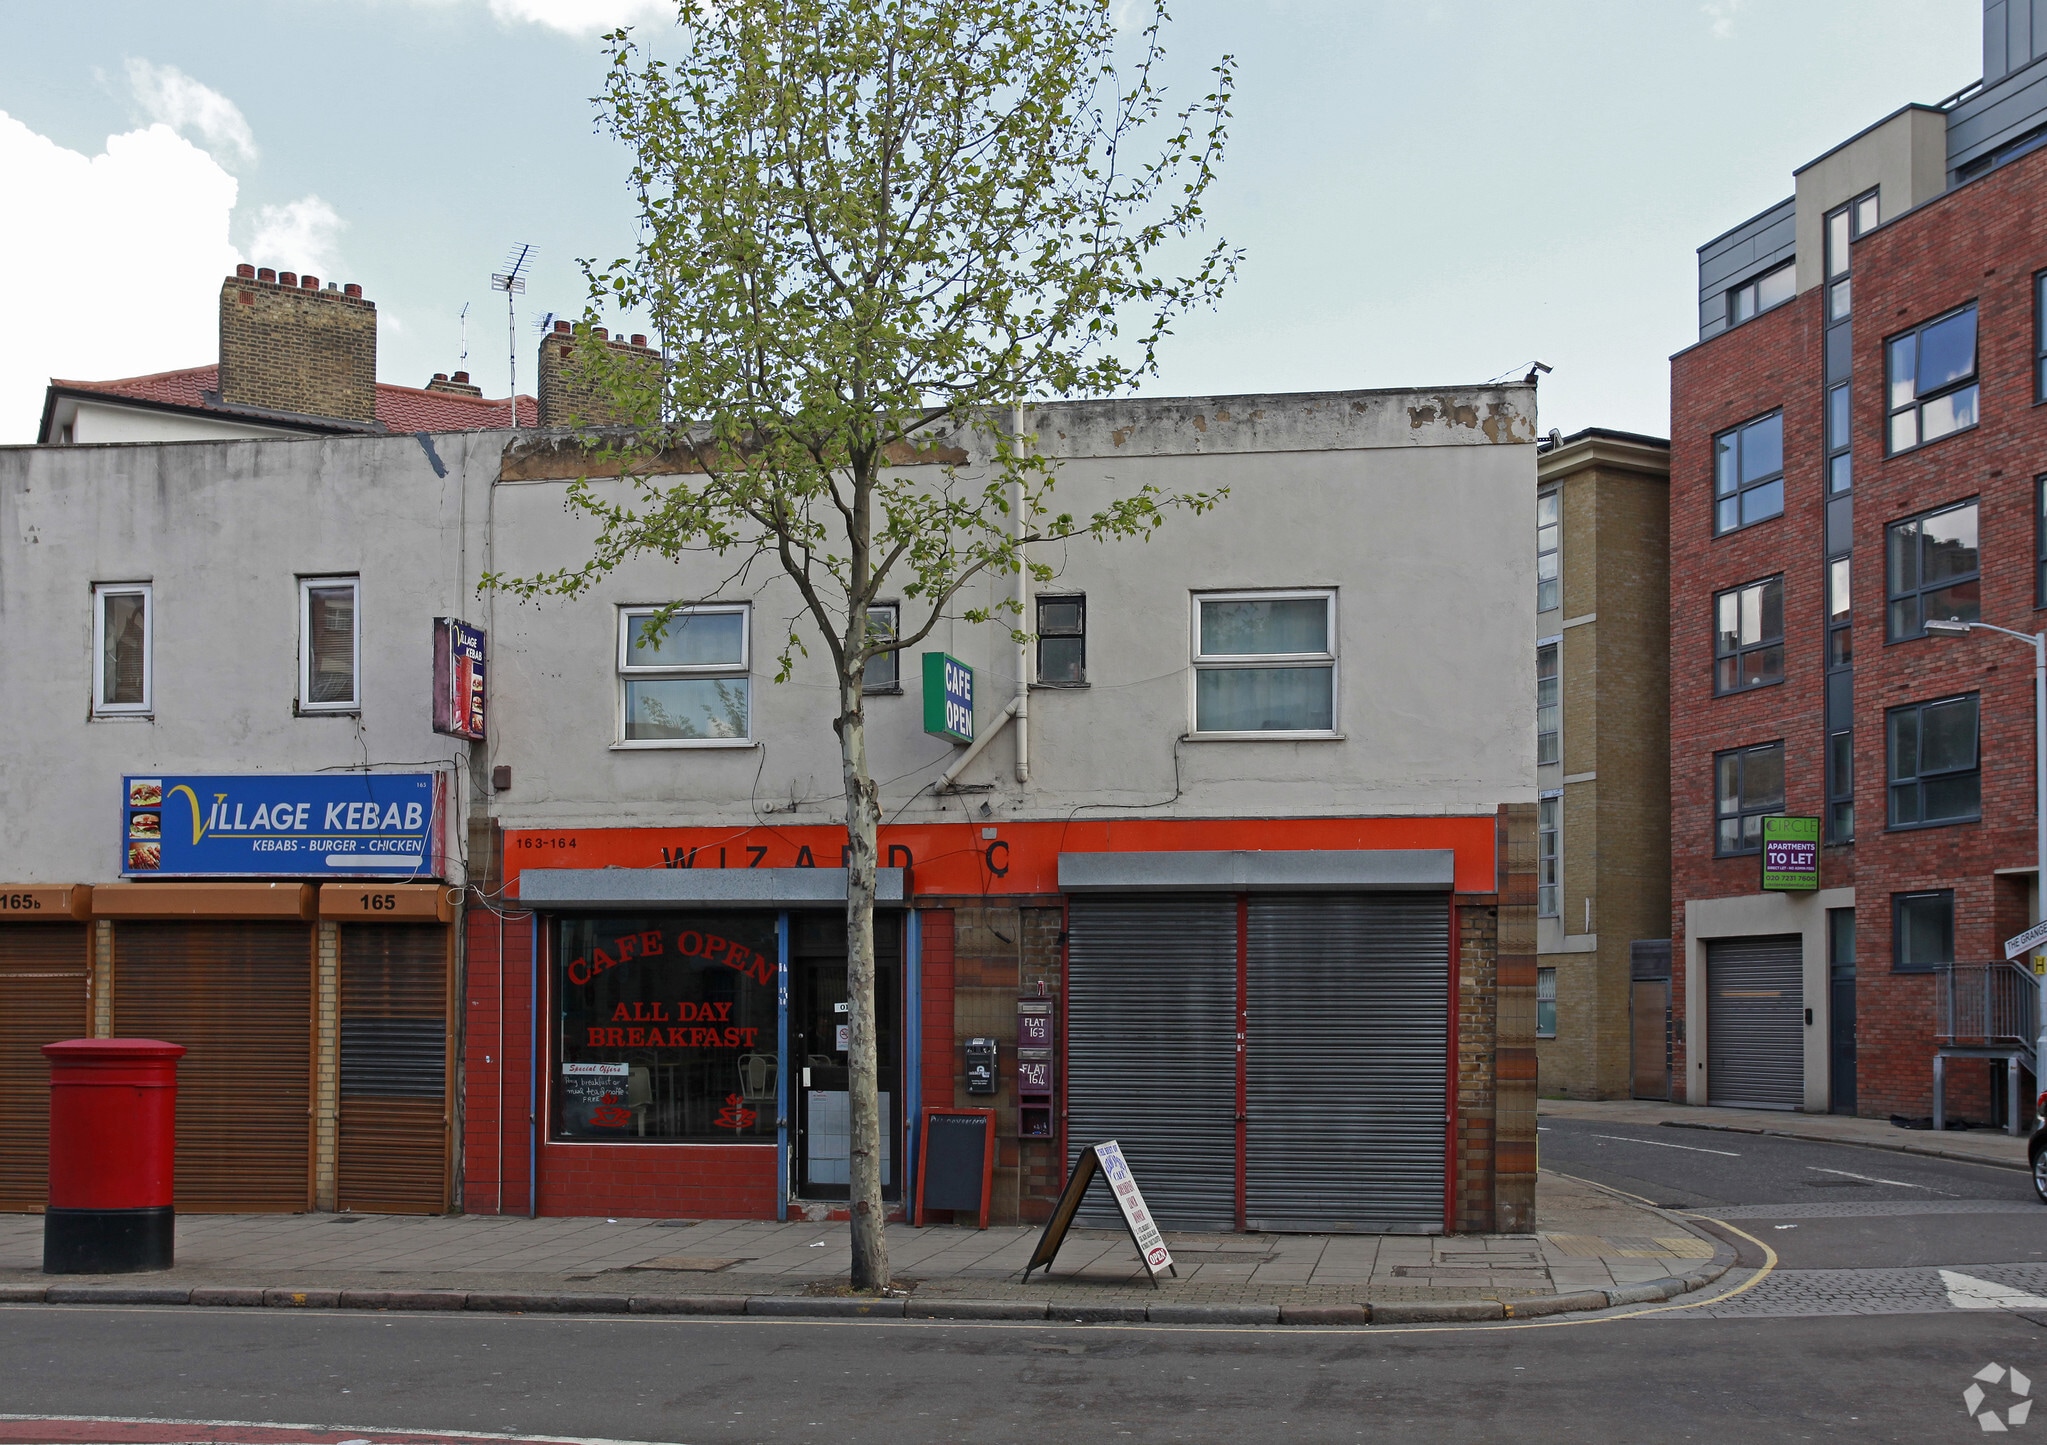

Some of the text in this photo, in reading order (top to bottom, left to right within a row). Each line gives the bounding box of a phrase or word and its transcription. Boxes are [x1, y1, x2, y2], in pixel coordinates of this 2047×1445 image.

[453, 625, 478, 648] VILLAGE
[465, 647, 483, 661] KEBAB
[945, 662, 971, 701] CAFE
[946, 700, 972, 737] OPEN
[167, 785, 423, 846] VILLAGE KEBAB
[1766, 819, 1817, 833] CIRCLE
[252, 839, 298, 852] KEBABS
[309, 839, 357, 852] BURGER
[369, 839, 422, 852] CHICKEN
[516, 838, 577, 849] 163-164
[1767, 843, 1816, 851] APARTMENTS
[663, 844, 913, 869] WIZAD
[1769, 852, 1813, 865] TO LET
[360, 894, 396, 910] 165
[2007, 938, 2020, 951] THE
[2020, 923, 2047, 944] GRANGE
[567, 930, 778, 986] CAFE OPEN
[611, 1001, 733, 1022] ALL DAY
[1024, 1018, 1045, 1027] FLAT
[587, 1027, 758, 1048] BREAKFAST
[1030, 1027, 1045, 1038] 163
[569, 1064, 597, 1072] Special
[1022, 1064, 1046, 1075] FLAT
[1029, 1073, 1045, 1085] 164
[1149, 1248, 1166, 1265] OPEN
